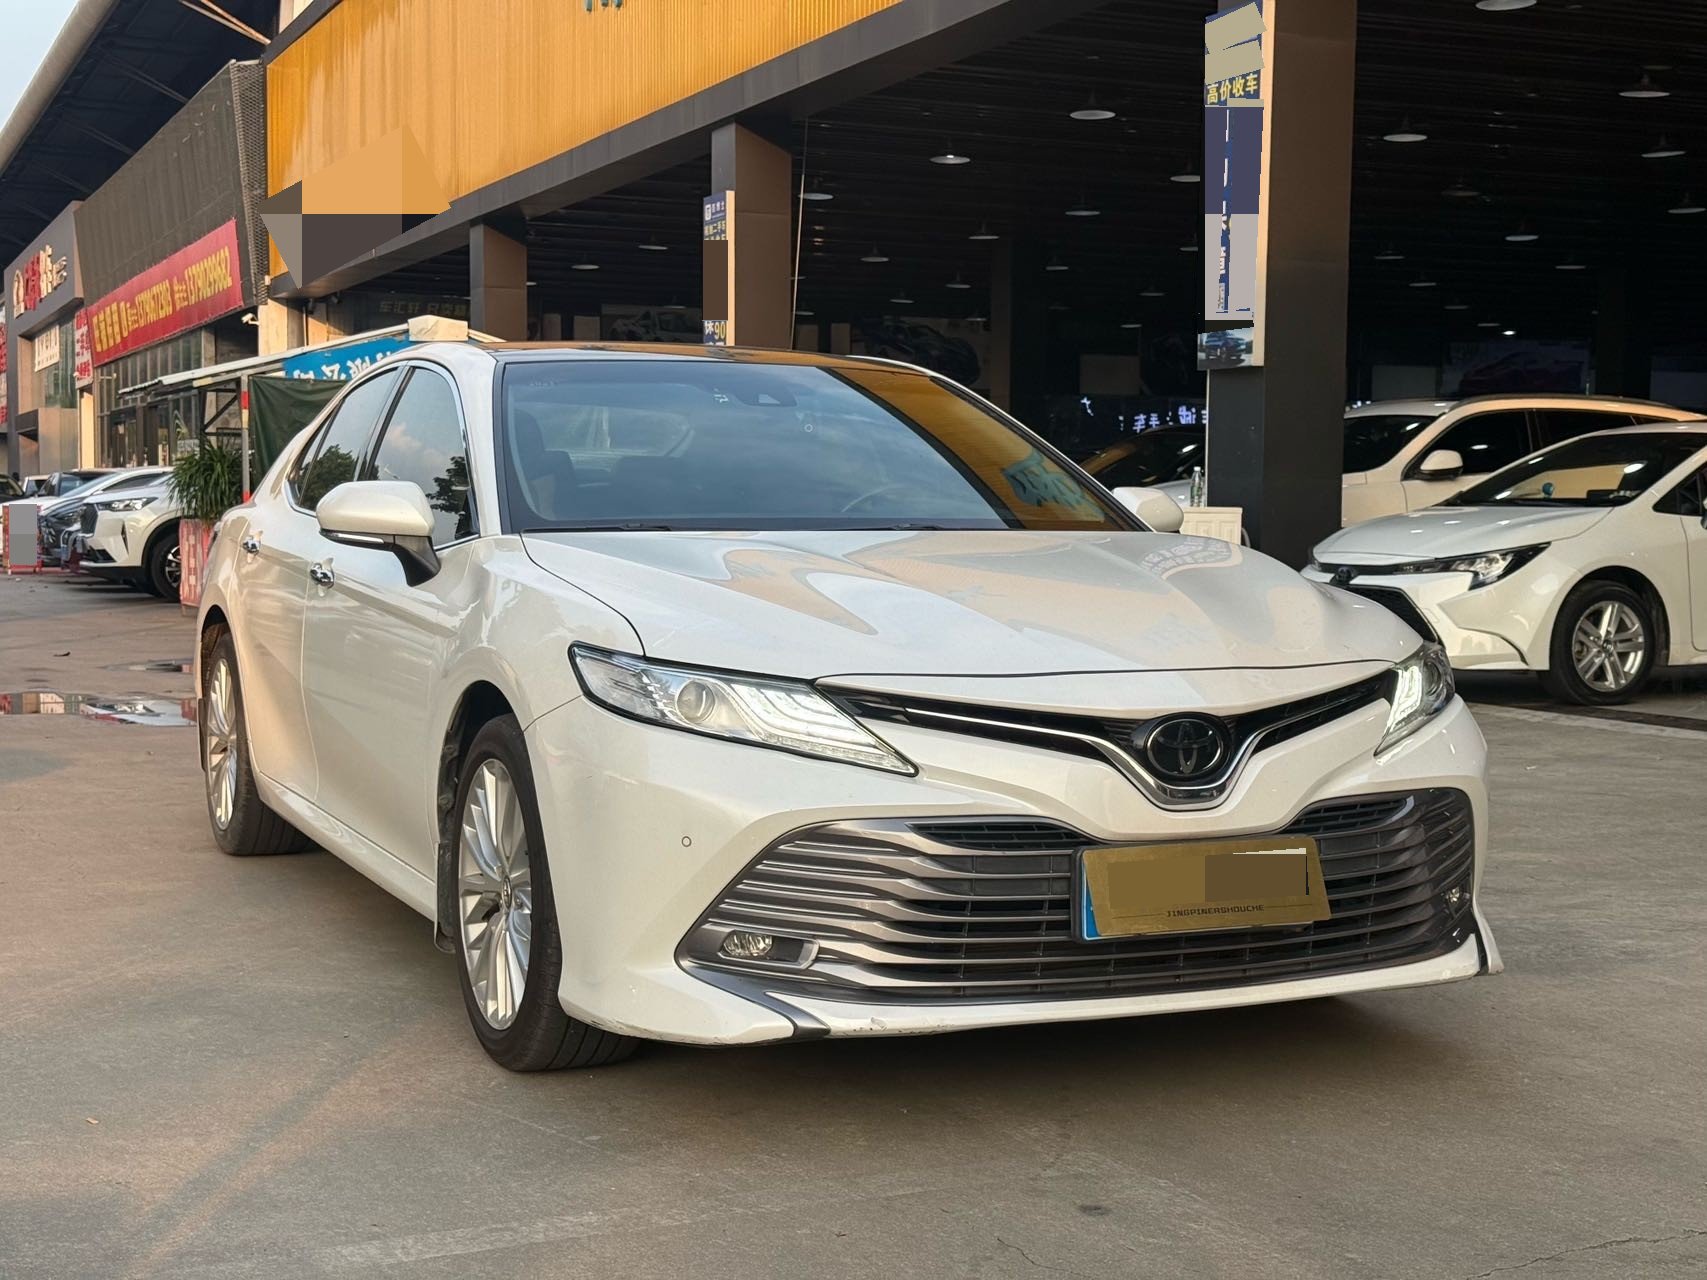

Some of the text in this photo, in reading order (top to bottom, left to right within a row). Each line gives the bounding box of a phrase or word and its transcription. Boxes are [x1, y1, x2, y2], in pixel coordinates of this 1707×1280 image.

[1207, 73, 1258, 104] 高价收车
[1166, 904, 1265, 918] JINGPINERSHOUCHE
